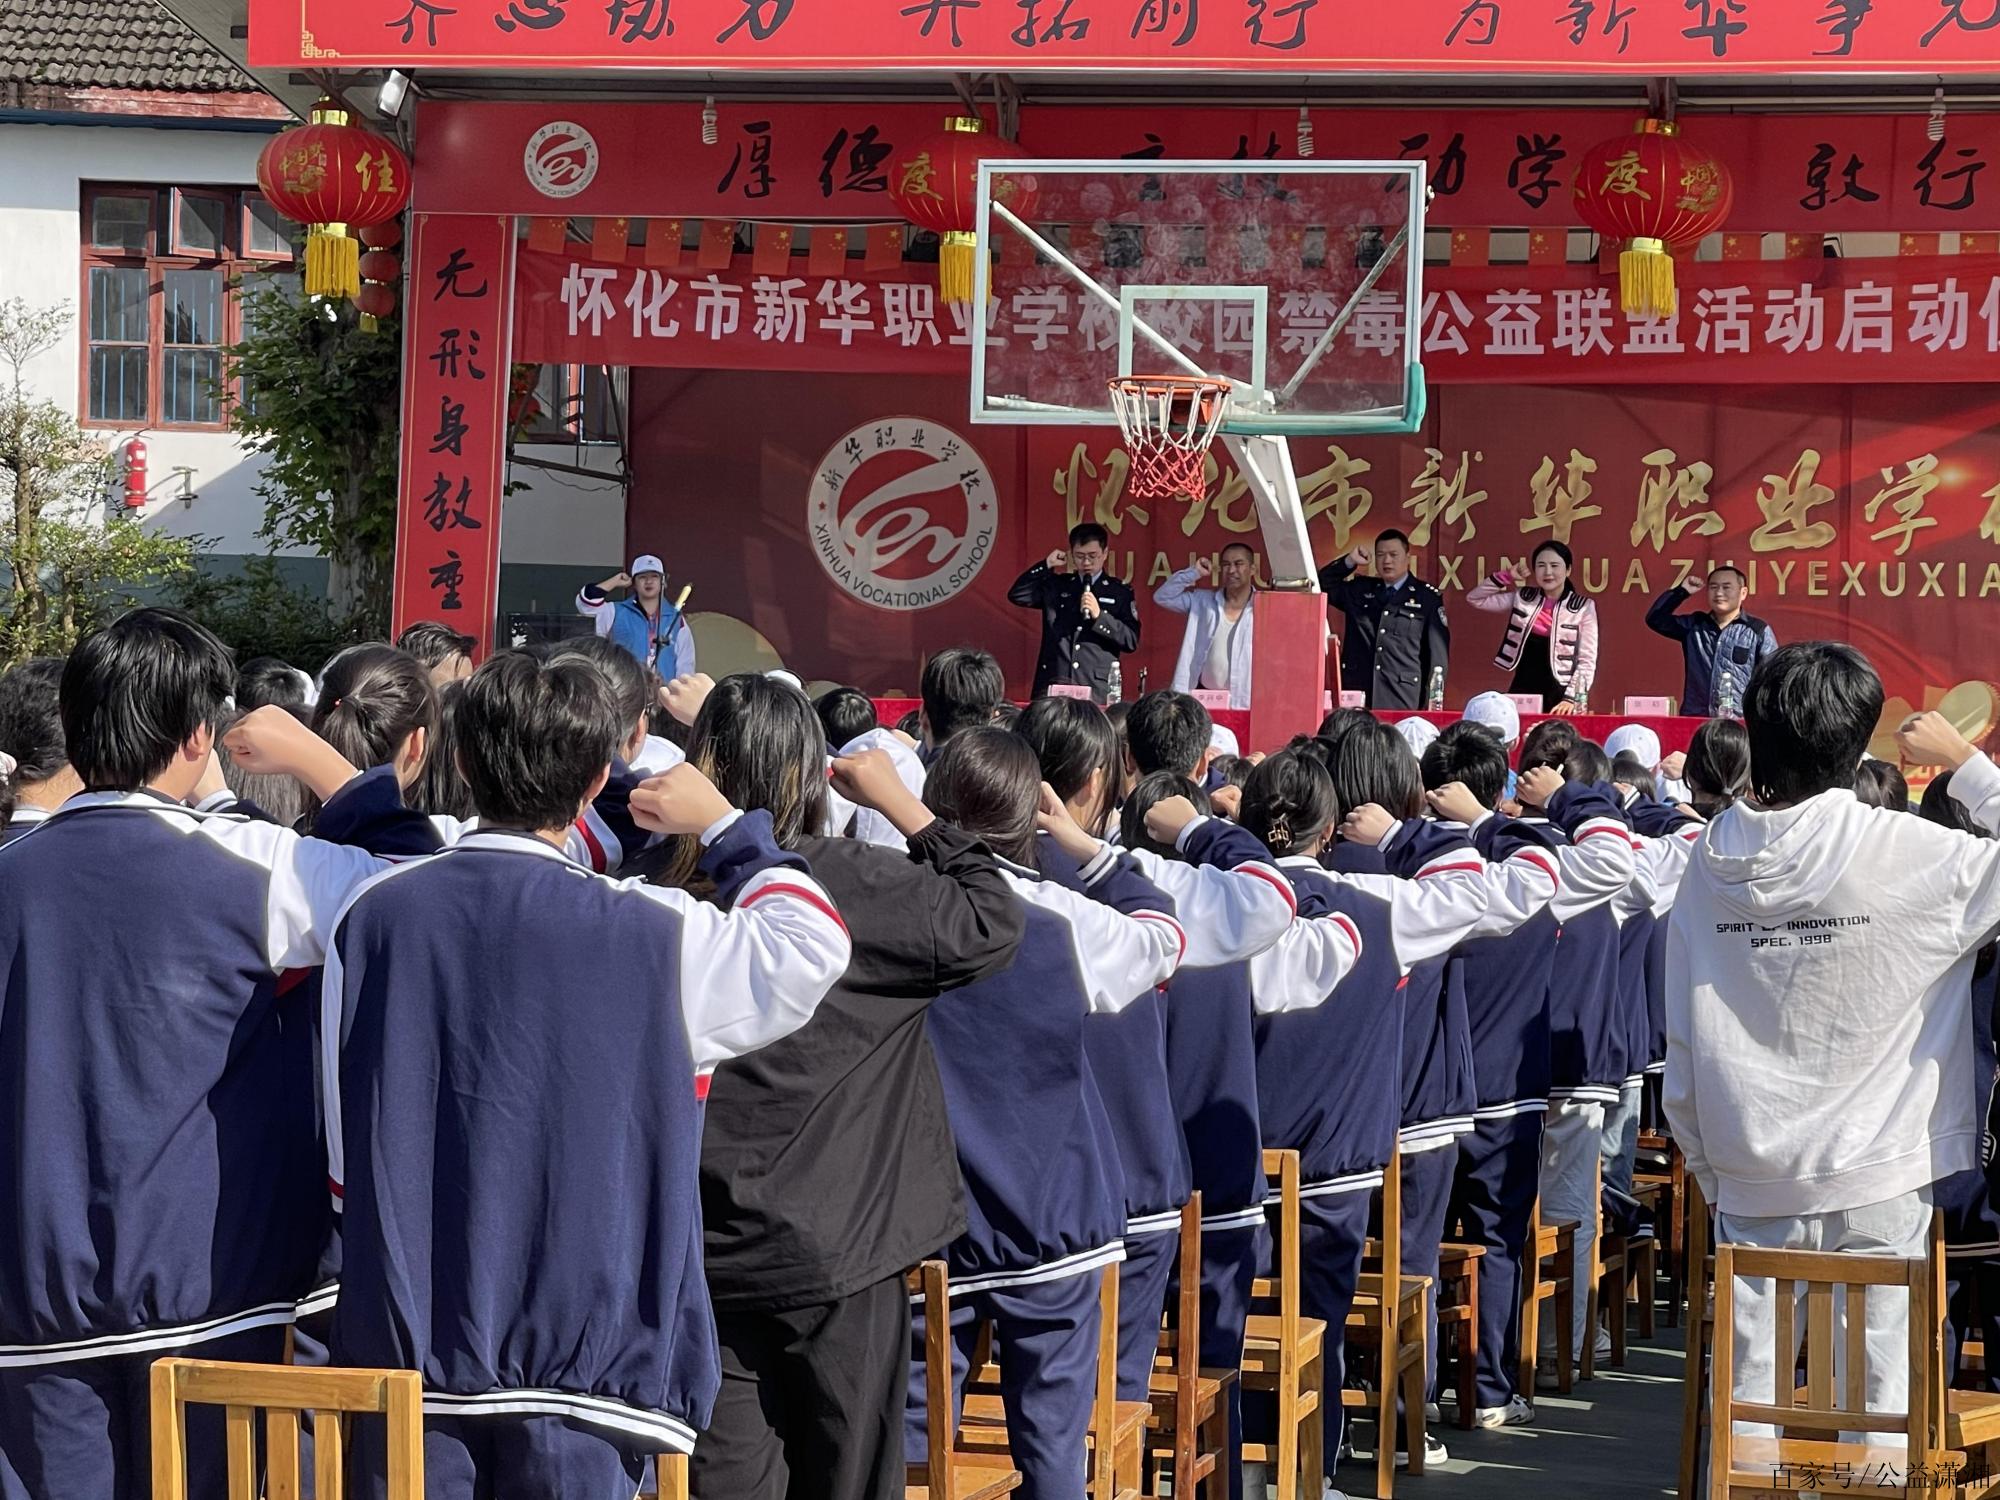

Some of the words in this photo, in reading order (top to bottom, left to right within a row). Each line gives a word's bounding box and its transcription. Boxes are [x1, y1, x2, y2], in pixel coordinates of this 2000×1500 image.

[355, 150, 398, 193] 佳
[717, 121, 893, 198] 厚德
[1799, 137, 1987, 211] 敦行
[901, 152, 945, 201] 度
[1600, 150, 1651, 201] 度
[423, 248, 488, 610] 无形身教重
[815, 523, 852, 584] XINHUA
[852, 576, 951, 607] VOCATIONAL
[949, 526, 993, 589] SCHOOL
[1716, 922, 1754, 933] SPIRIT
[1787, 915, 1871, 931] INNOVATION
[1750, 937, 1792, 948] SPEC.
[1800, 934, 1832, 945] 1998
